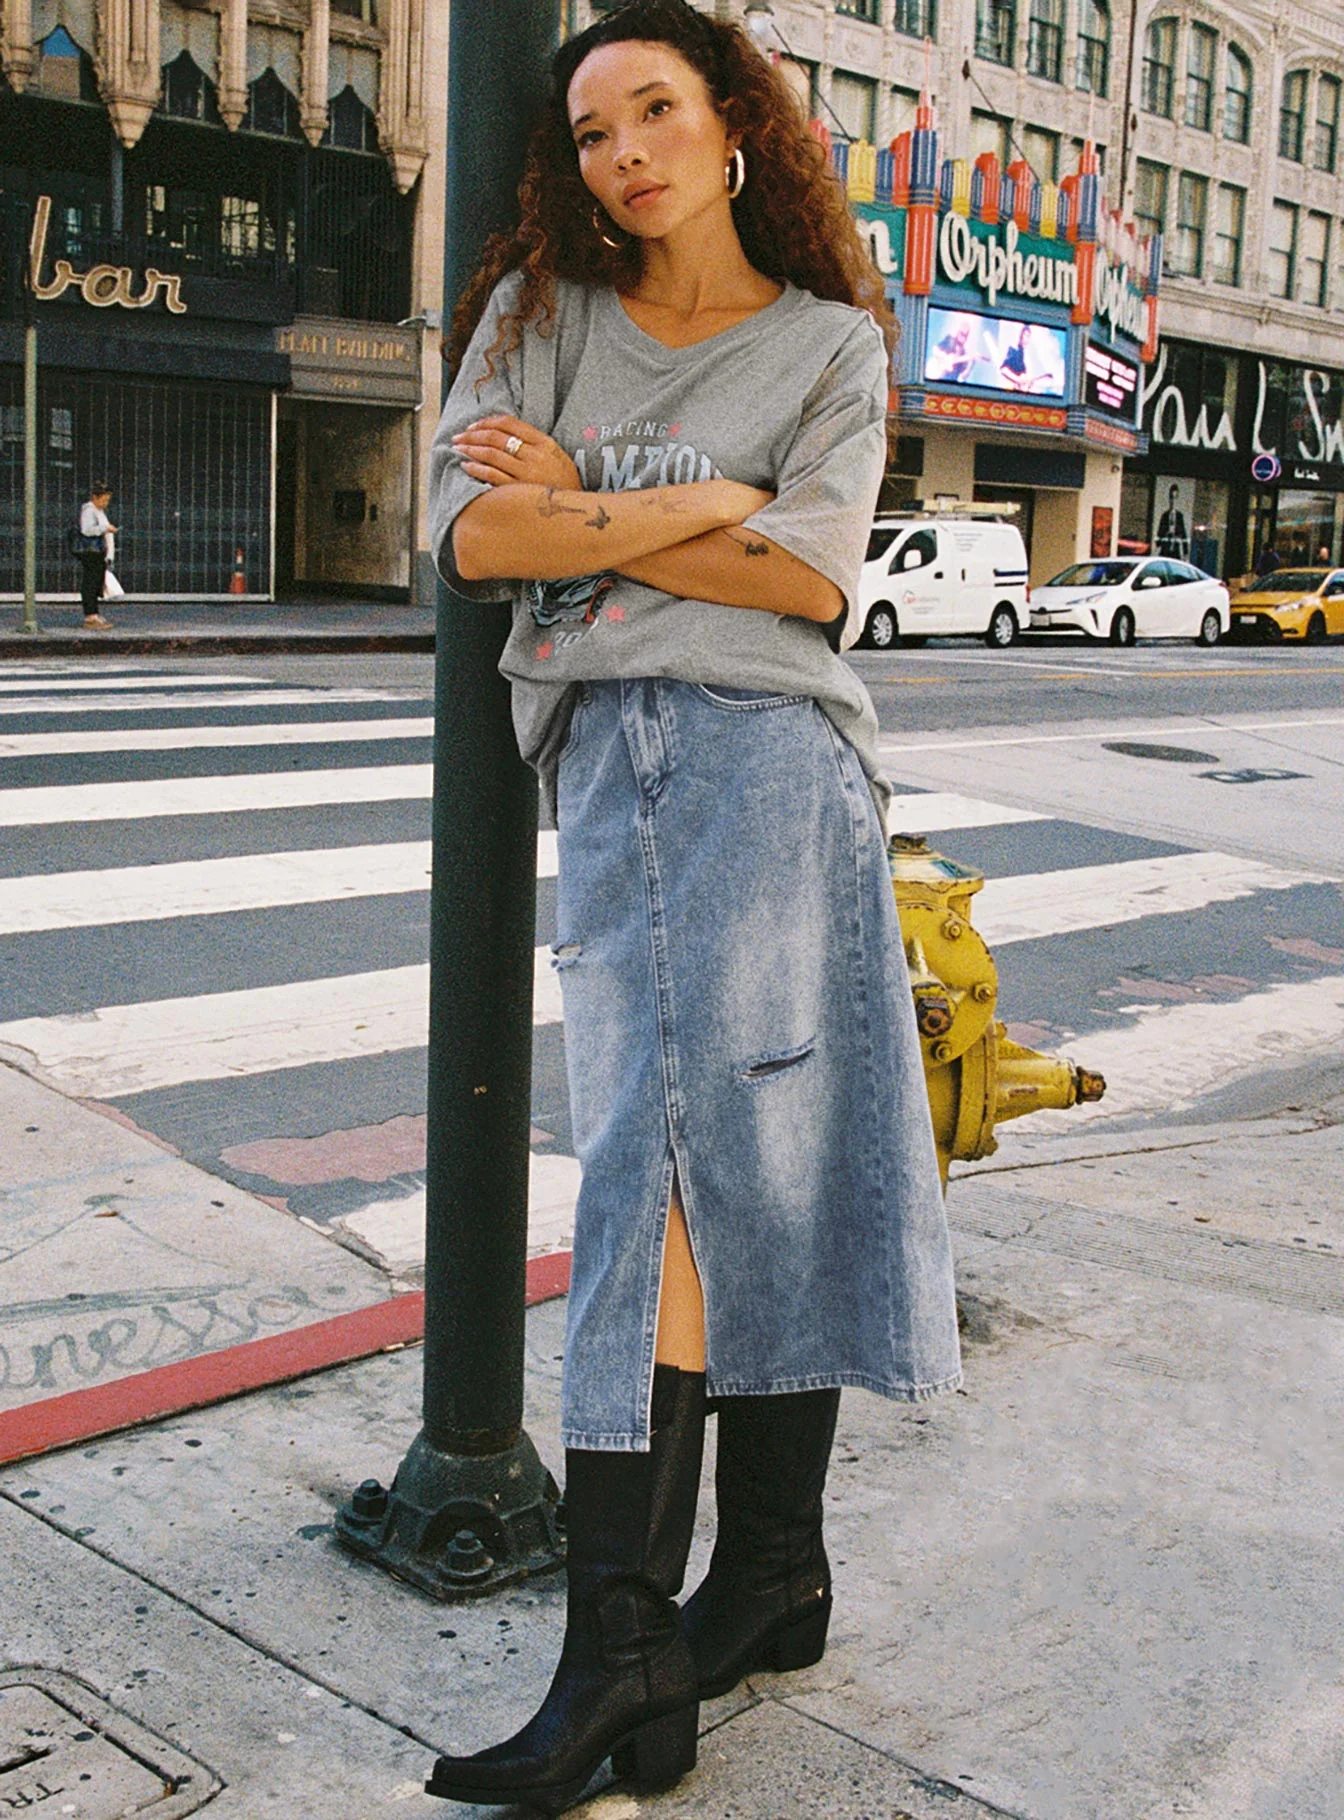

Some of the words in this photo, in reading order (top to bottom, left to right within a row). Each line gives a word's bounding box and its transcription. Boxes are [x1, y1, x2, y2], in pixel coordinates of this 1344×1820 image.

[30, 195, 187, 314] bar
[940, 210, 1080, 307] Orpheum
[600, 420, 669, 440] RACING
